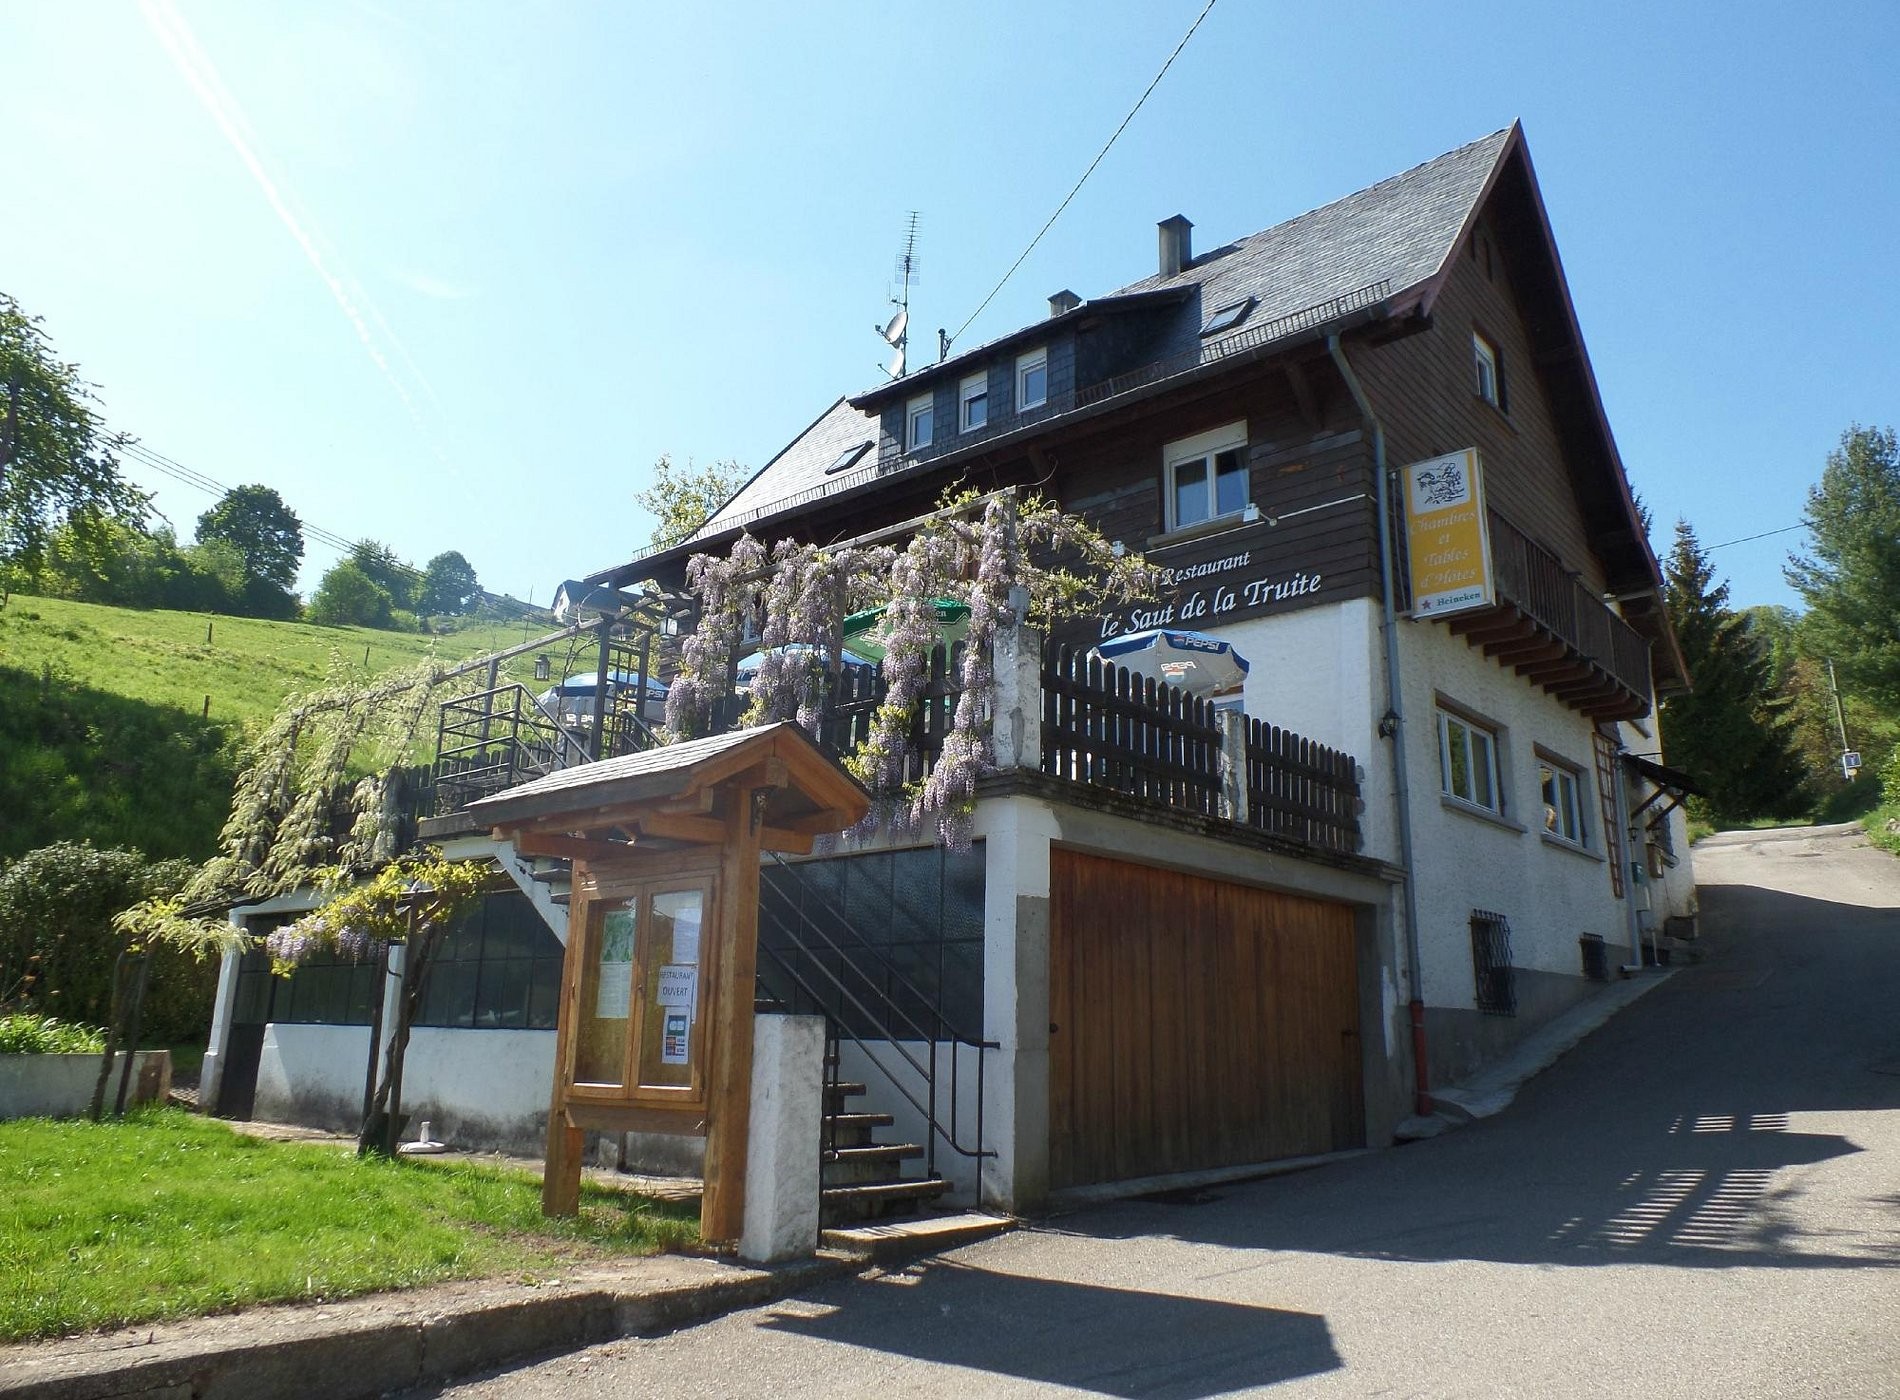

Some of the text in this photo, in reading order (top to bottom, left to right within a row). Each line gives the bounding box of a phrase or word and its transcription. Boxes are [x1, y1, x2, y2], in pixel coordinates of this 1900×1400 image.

[1410, 510, 1476, 534] Chambres
[1438, 533, 1450, 545] et
[1424, 548, 1469, 567] Tables
[1160, 551, 1251, 587] Restaurant
[1125, 603, 1174, 635] Saut
[1181, 592, 1207, 620] de
[1213, 586, 1237, 614] la
[1244, 572, 1321, 607] Truite
[1437, 592, 1481, 607] Heineken
[1185, 636, 1220, 651] PEPSI
[662, 986, 688, 996] OUVERT
